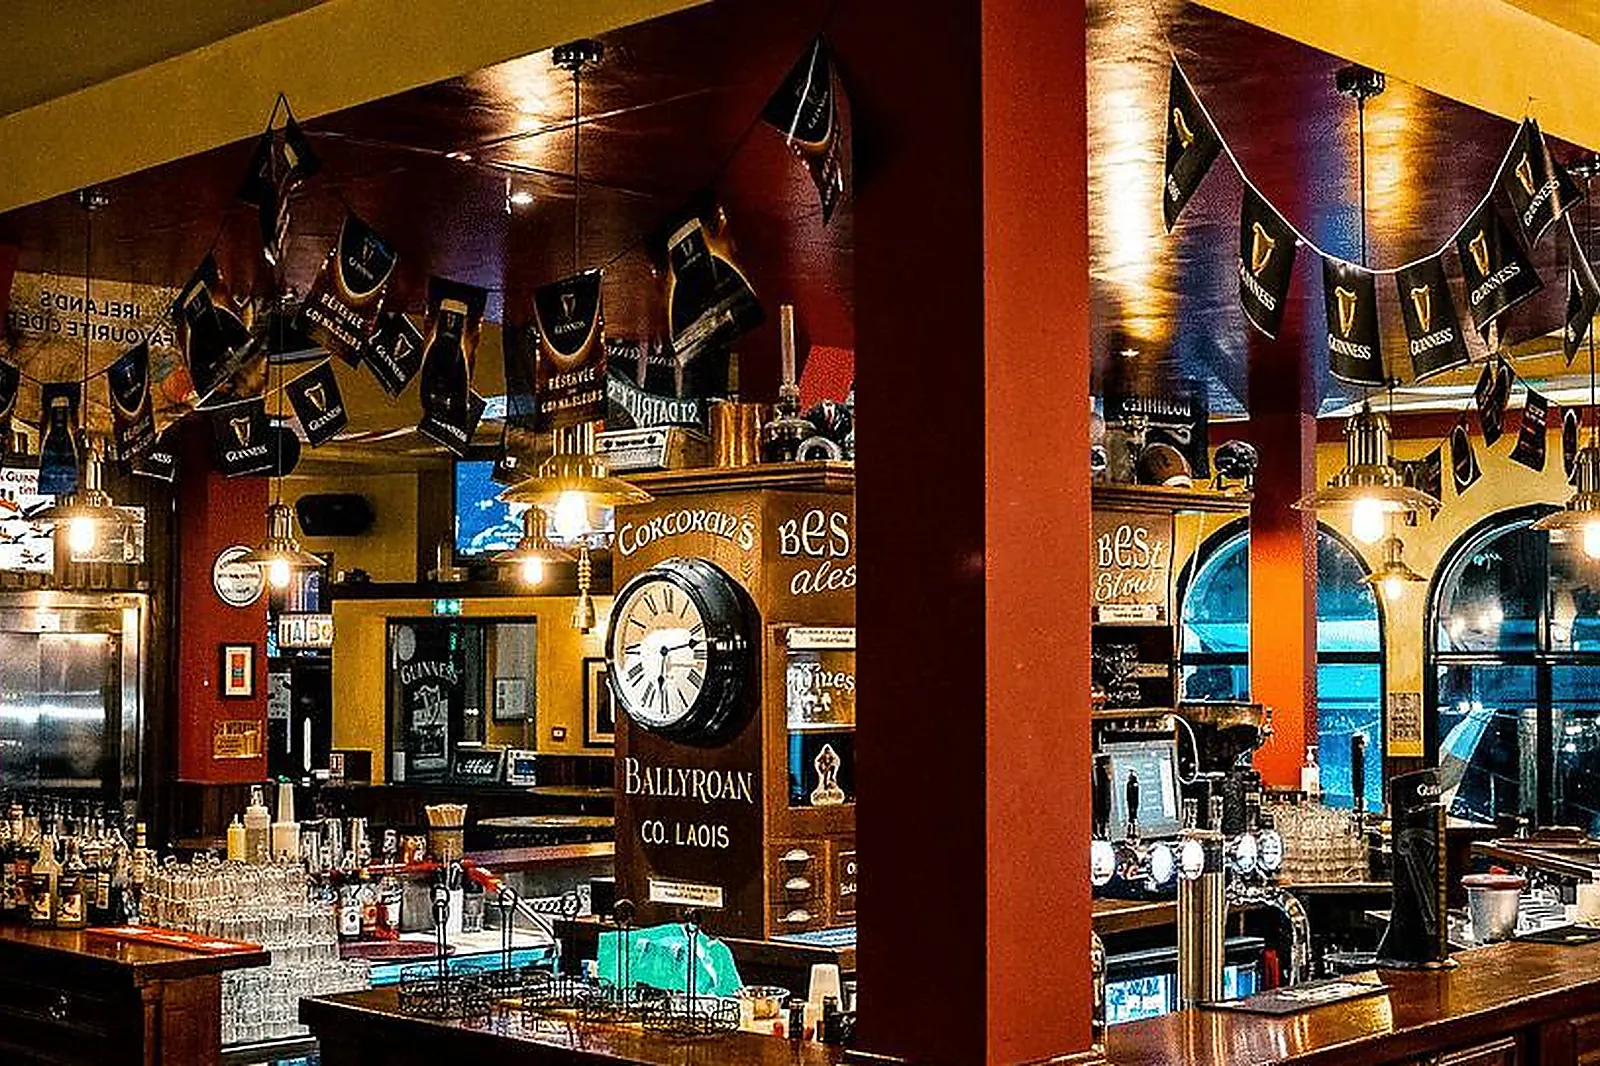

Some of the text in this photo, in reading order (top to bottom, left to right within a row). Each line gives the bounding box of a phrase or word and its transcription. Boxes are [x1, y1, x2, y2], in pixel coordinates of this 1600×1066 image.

[1523, 178, 1560, 227] GUINNESS
[1471, 261, 1521, 306] GUINNESS
[1326, 332, 1372, 361] GUINNESS
[1410, 327, 1454, 357] GUINNESS
[790, 560, 857, 596] ales
[624, 757, 753, 804] BALLYROAN
[641, 820, 730, 849] CO. LAOIS
